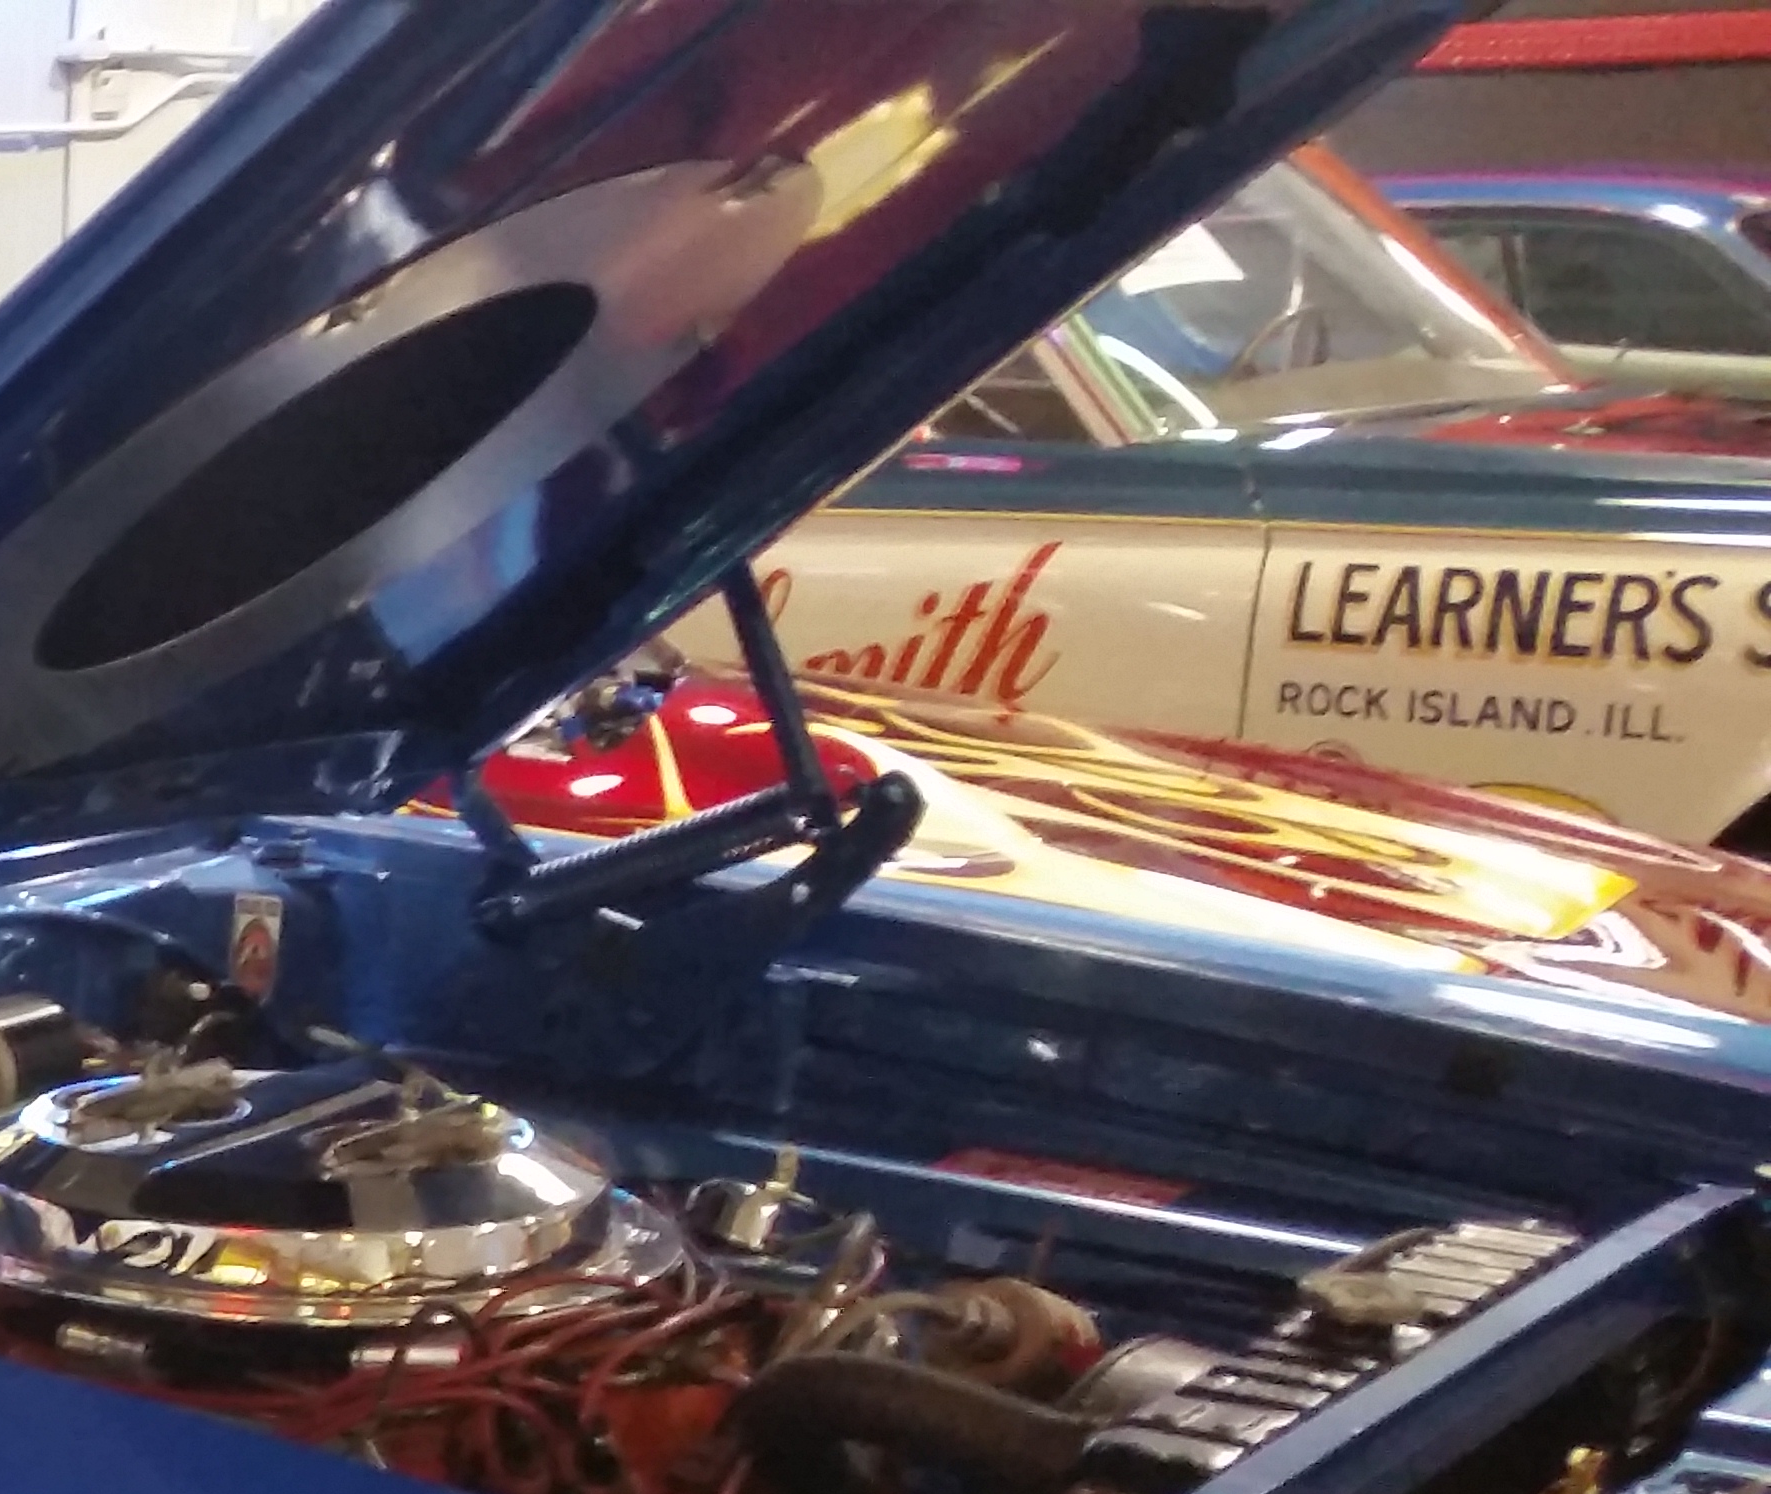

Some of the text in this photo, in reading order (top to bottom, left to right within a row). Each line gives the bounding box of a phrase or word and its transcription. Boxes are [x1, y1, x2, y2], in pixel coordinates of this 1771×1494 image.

[759, 540, 1063, 702] mith
[1289, 560, 1721, 665] LEARNER'S
[1276, 681, 1389, 721] ROCK
